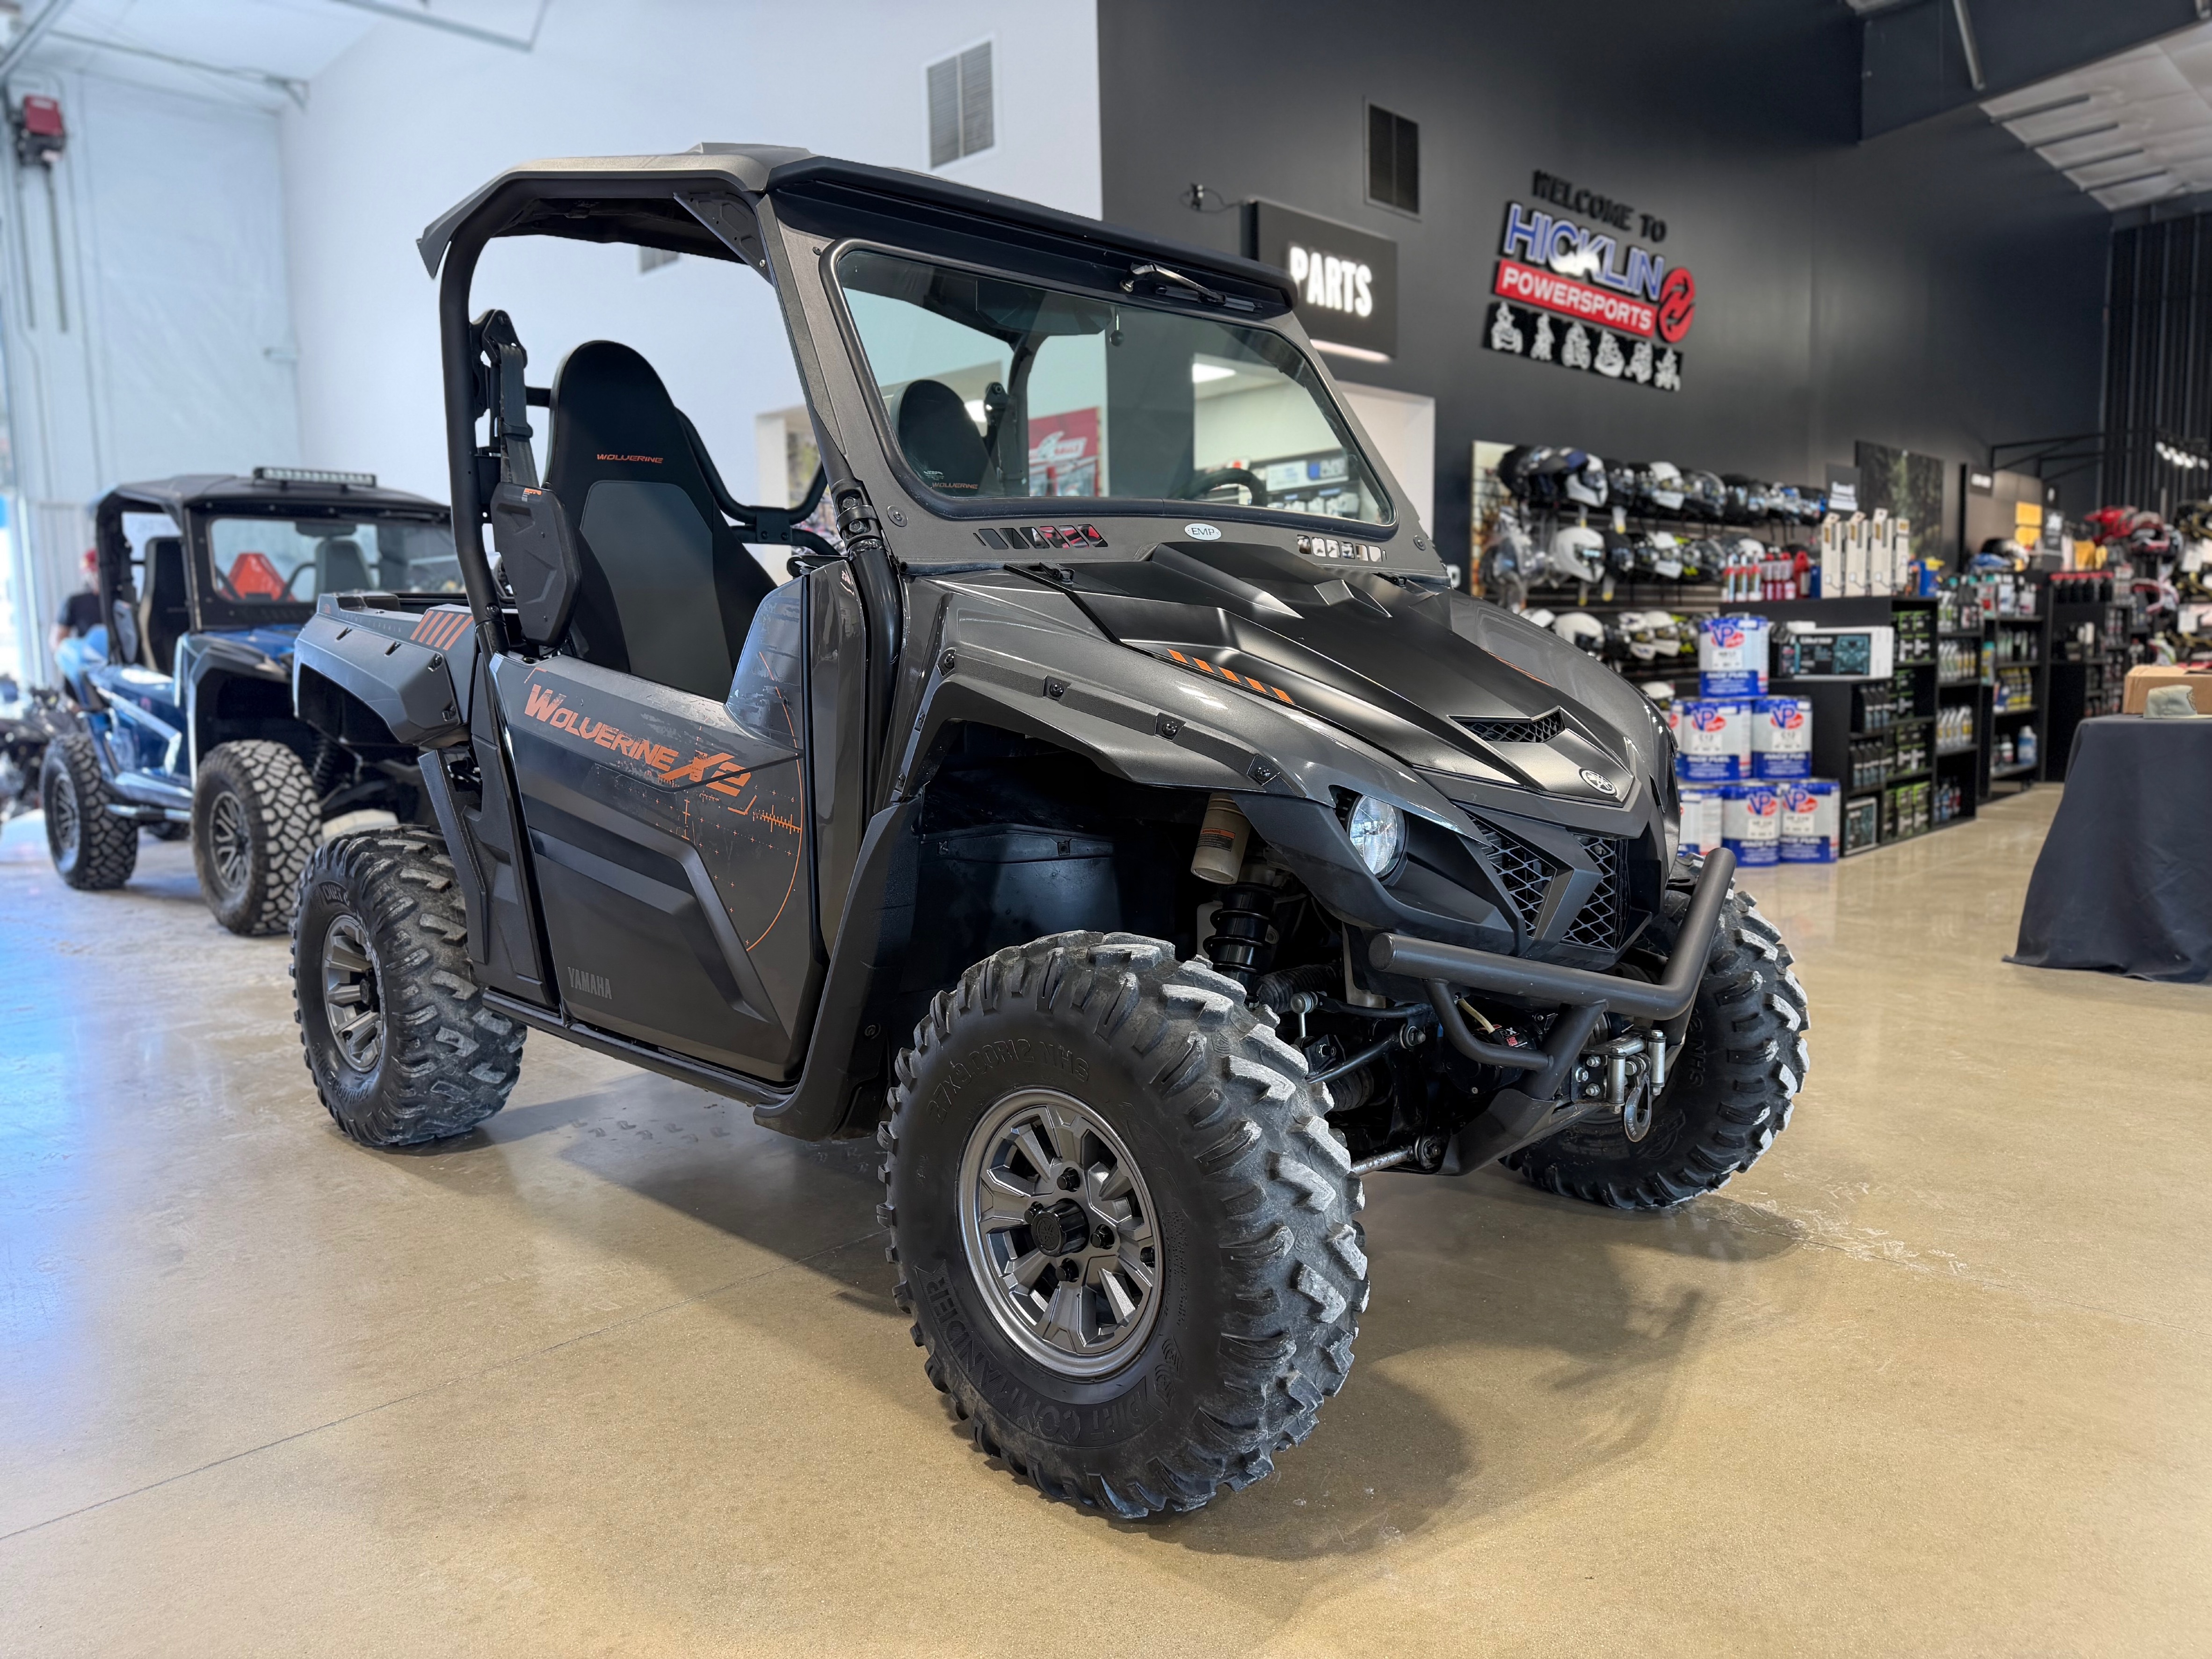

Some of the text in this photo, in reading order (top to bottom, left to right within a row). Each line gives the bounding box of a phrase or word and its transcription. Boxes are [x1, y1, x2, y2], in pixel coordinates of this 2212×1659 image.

[1532, 170, 1667, 242] WELCOME TO
[1502, 203, 1666, 301] HICKLIN
[1290, 246, 1372, 317] PARTS
[1501, 265, 1654, 330] POWERSPORTS
[597, 454, 663, 464] WOLVERINE
[1712, 625, 1733, 647] VP
[1692, 709, 1716, 731] VP
[1772, 706, 1796, 728] VP
[524, 684, 751, 797] WOLVERINE X2
[1748, 793, 1771, 815] VP
[1783, 788, 1808, 811] VP
[567, 967, 612, 999] YAMAHA
[925, 1277, 1081, 1445] COMMANDER
